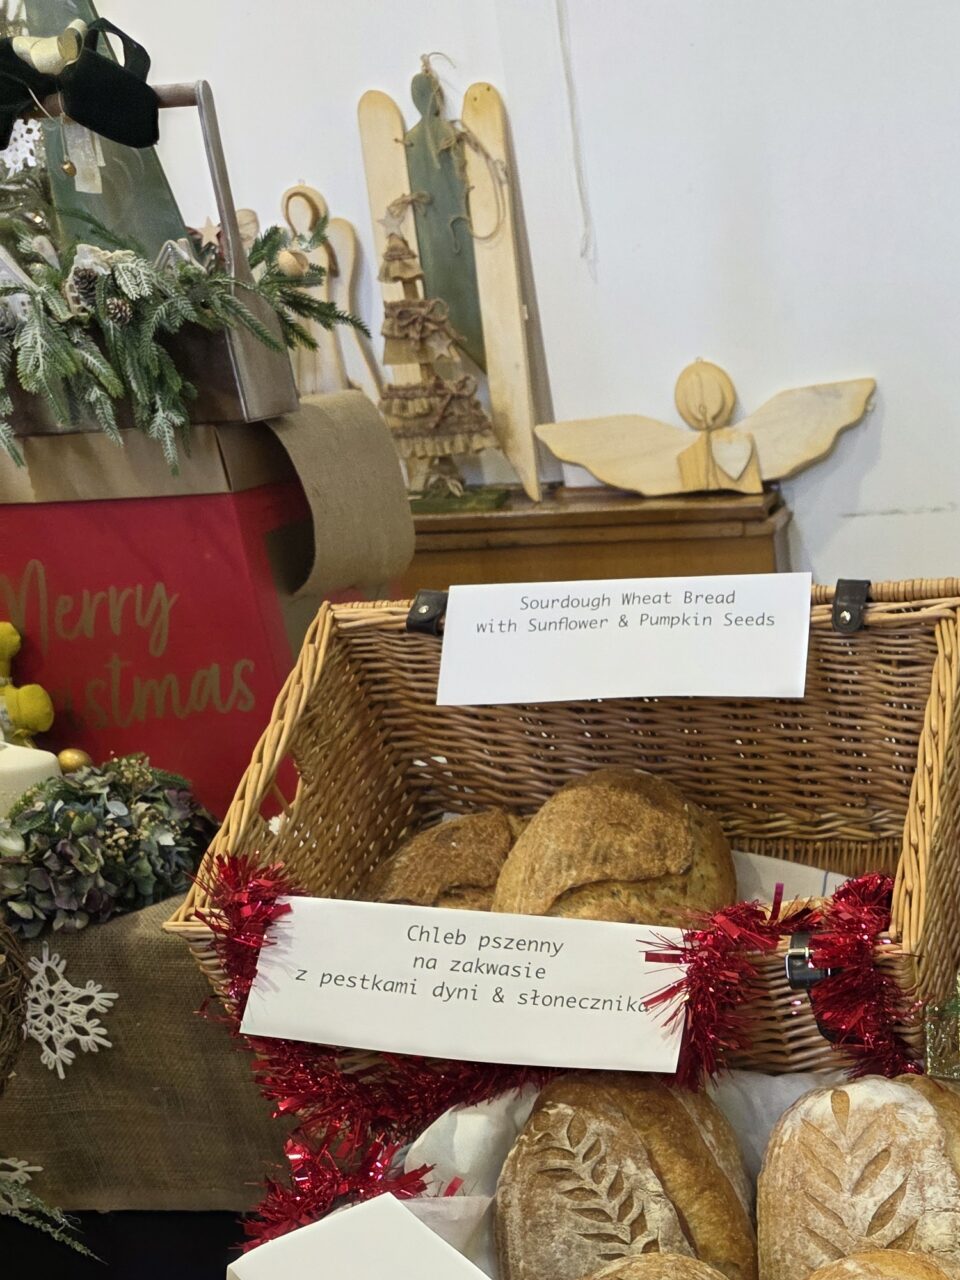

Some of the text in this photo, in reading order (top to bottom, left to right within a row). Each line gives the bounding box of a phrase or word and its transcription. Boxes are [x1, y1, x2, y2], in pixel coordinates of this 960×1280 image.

[0, 559, 179, 657] Merry
[519, 590, 736, 612] Sourdough Wheat Bread
[476, 611, 776, 634] with Sunflower & Pumpkin Seeds
[406, 924, 565, 957] Chleb pszenny
[413, 955, 547, 980] na zakwasie
[294, 968, 308, 982] z
[319, 971, 418, 996] pestkami
[432, 981, 479, 1002] dyni
[491, 986, 505, 1004] &
